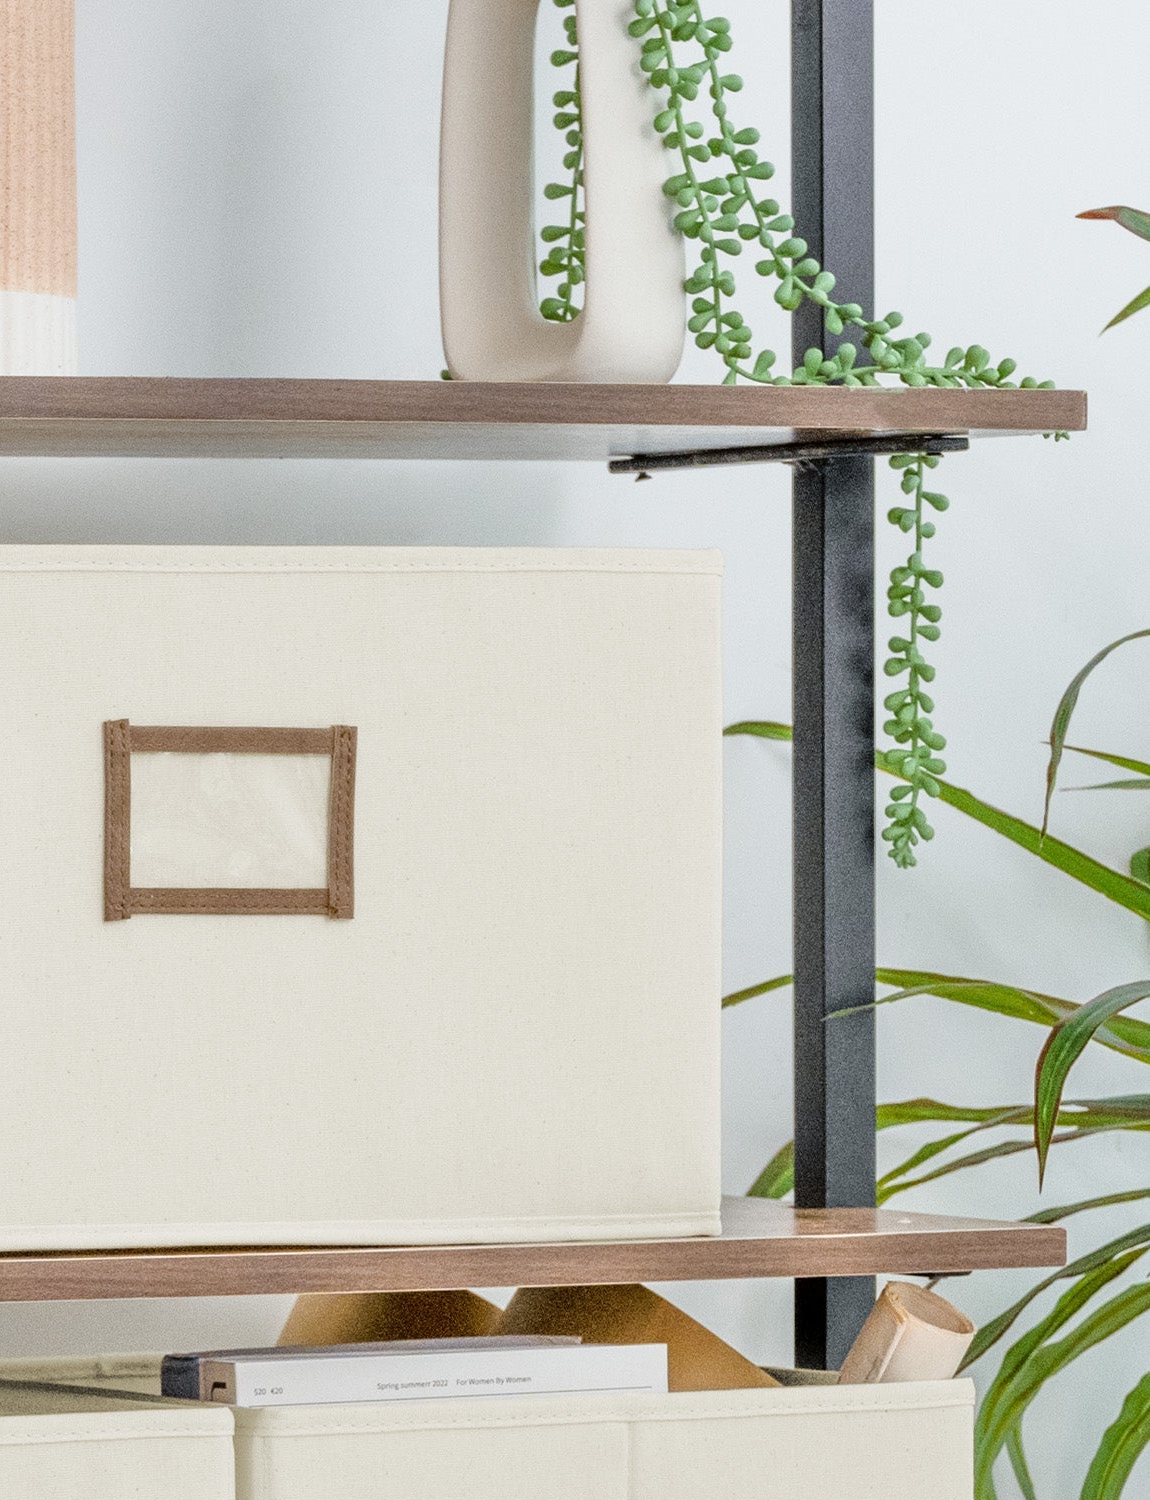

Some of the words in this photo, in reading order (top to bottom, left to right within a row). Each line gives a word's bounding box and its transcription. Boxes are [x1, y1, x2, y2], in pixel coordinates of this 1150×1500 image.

[377, 1382, 399, 1391] Spring
[432, 1379, 448, 1388] 2022
[456, 1378, 467, 1386] For
[469, 1378, 495, 1386] Women
[496, 1376, 505, 1385] By
[506, 1376, 532, 1384] Women
